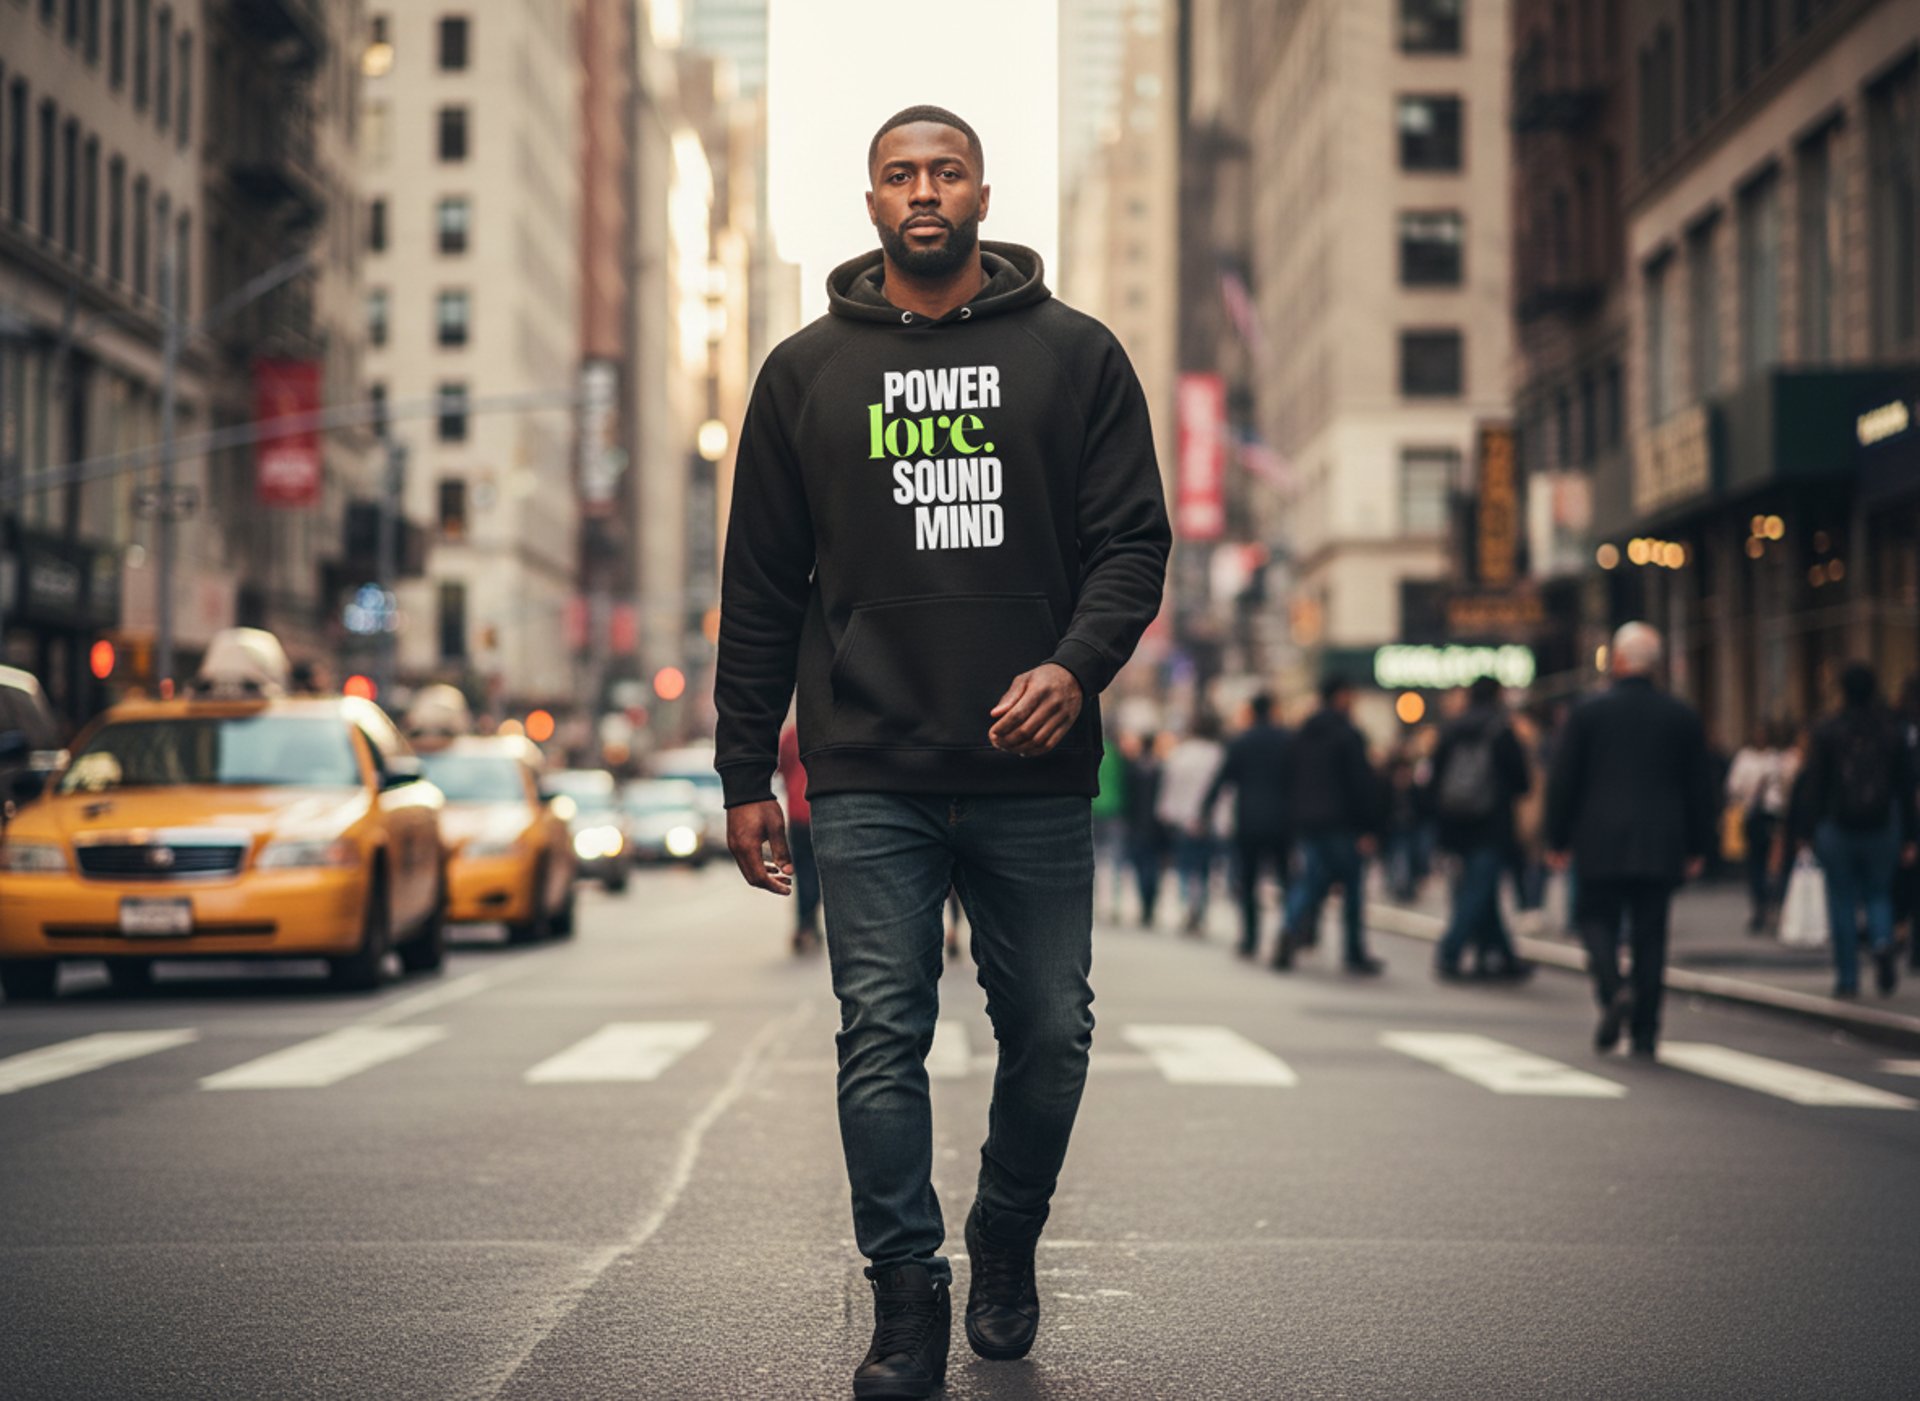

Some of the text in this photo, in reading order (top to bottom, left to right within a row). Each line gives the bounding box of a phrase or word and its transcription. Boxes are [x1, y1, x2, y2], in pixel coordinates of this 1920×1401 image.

[884, 366, 1000, 414] POWER
[868, 403, 995, 459] love.
[893, 457, 1002, 505] SOUND
[915, 504, 1004, 550] MIND
